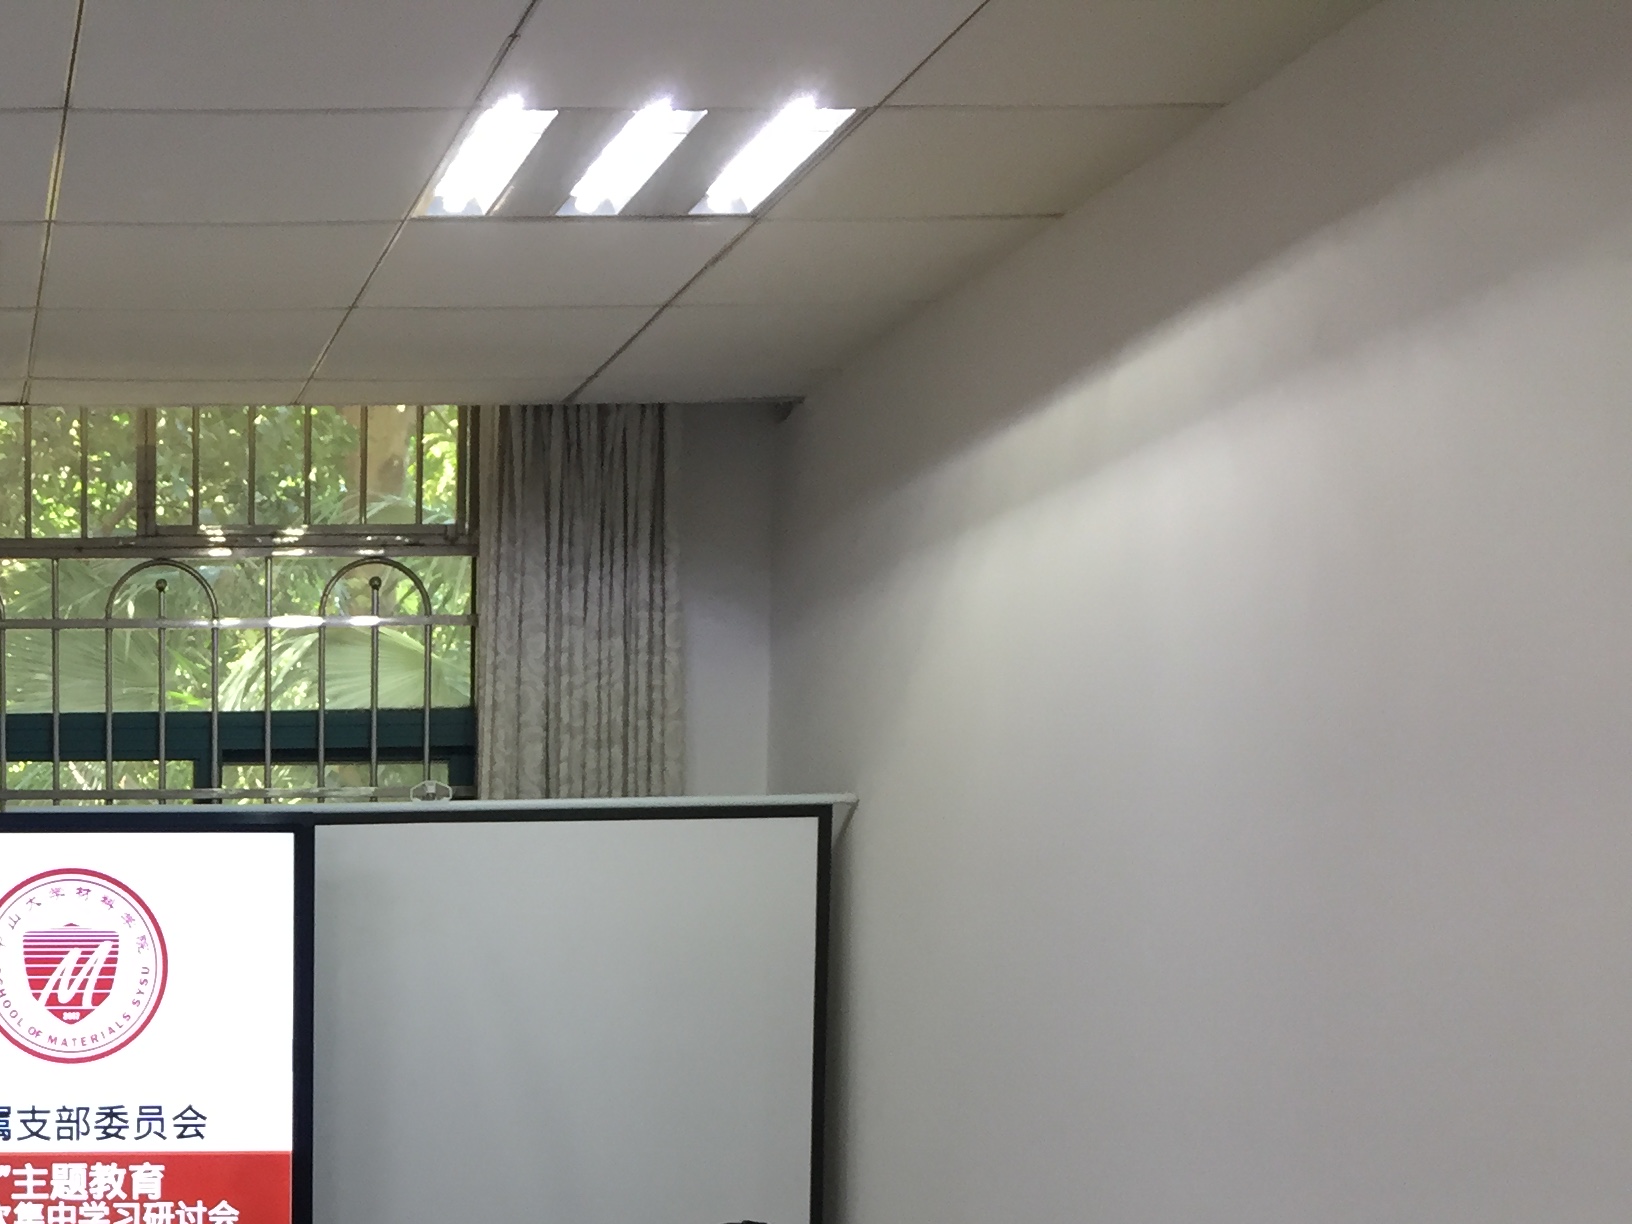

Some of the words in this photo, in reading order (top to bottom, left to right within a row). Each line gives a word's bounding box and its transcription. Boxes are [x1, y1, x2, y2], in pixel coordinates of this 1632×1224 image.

[28, 1026, 43, 1039] OF
[47, 1012, 131, 1047] MATERIALS
[131, 966, 151, 1008] SYSU
